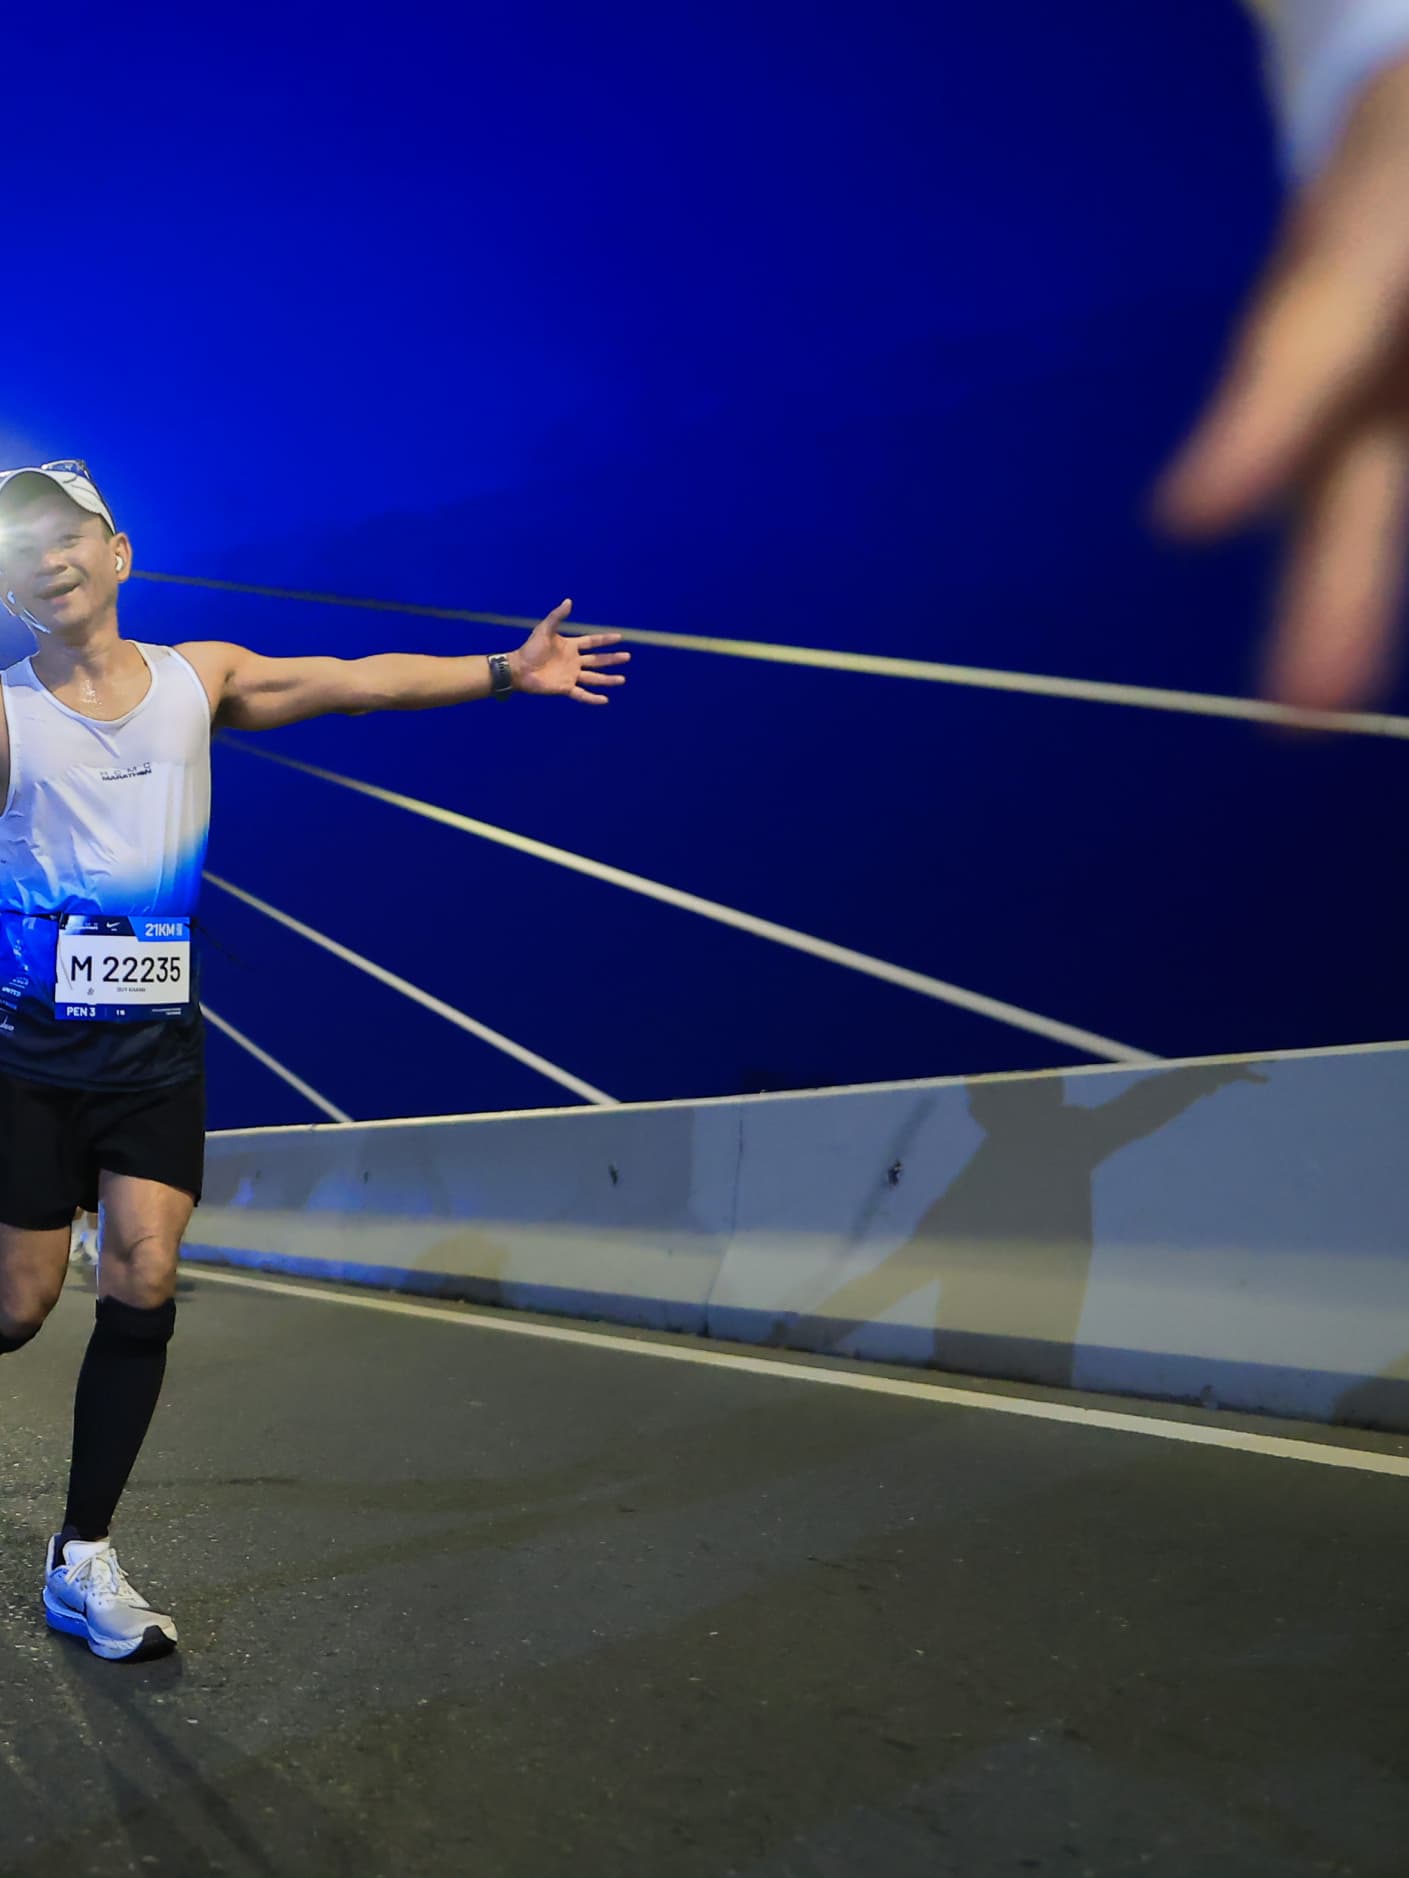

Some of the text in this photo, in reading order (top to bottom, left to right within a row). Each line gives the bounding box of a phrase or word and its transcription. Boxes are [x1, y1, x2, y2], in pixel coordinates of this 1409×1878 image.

[145, 923, 174, 937] 21KM
[71, 955, 181, 983] M 22235
[66, 1006, 96, 1017] PEN 3
